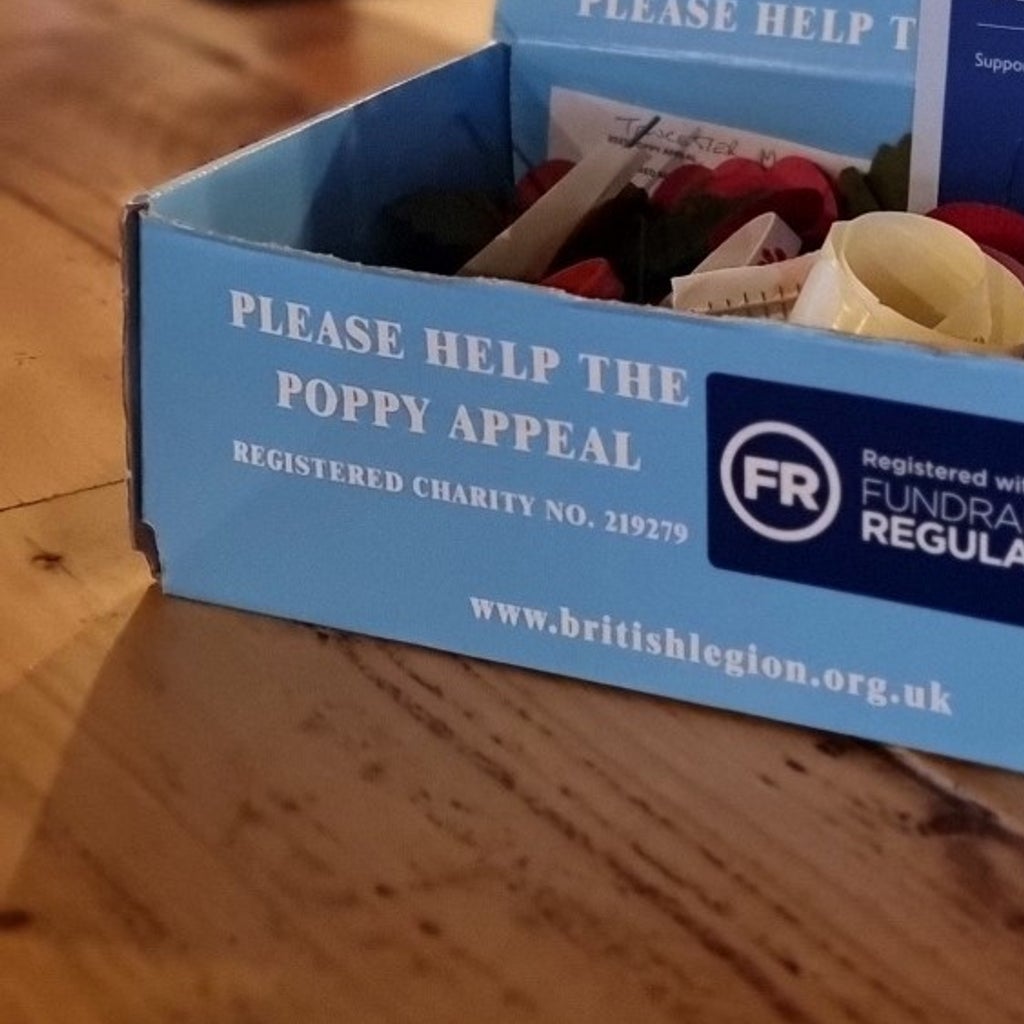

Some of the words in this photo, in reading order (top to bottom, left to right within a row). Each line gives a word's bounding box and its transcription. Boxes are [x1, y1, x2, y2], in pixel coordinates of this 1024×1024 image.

[754, 2, 874, 45] HELP
[229, 289, 405, 360] PLEASE
[423, 327, 561, 385] HELP
[578, 353, 690, 408] THE
[276, 369, 430, 434] POPPY
[448, 404, 641, 472] APPEAL
[862, 448, 987, 489] Registered
[232, 440, 403, 493] REGISTERED
[412, 476, 535, 517] CHARITY
[545, 499, 594, 528] NO.
[604, 509, 689, 545] 219279
[743, 455, 820, 511] FR
[468, 595, 953, 717] www.britishlegion.org.uk
